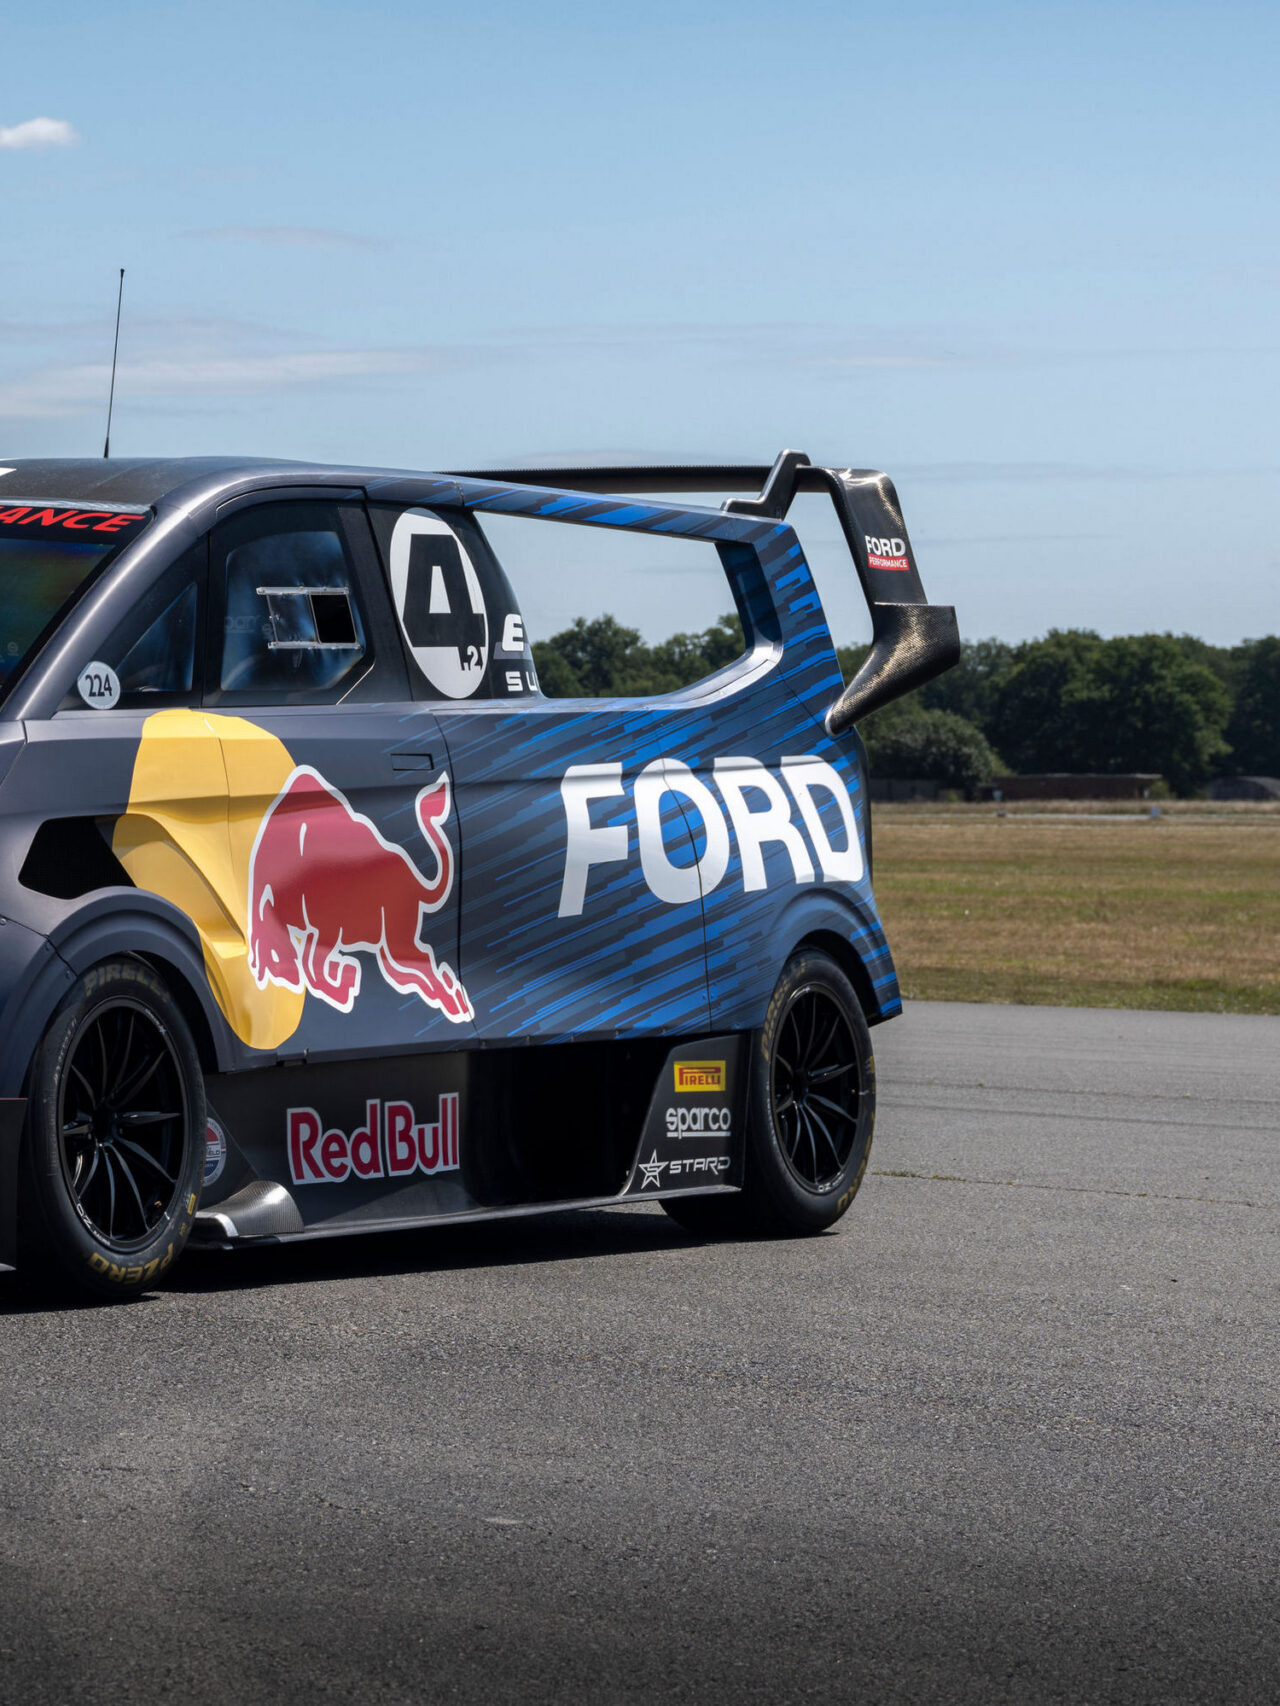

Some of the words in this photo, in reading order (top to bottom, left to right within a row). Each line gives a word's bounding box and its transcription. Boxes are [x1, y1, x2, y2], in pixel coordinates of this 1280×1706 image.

[864, 535, 906, 557] FORD
[869, 556, 908, 568] PERFORMANCE
[85, 673, 112, 697] 224
[558, 755, 864, 918] FORD
[678, 1066, 722, 1087] PIRELLI
[665, 1107, 732, 1139] sparco
[288, 1100, 383, 1183] Red
[385, 1093, 460, 1176] Bull
[669, 1156, 731, 1175] STARD
